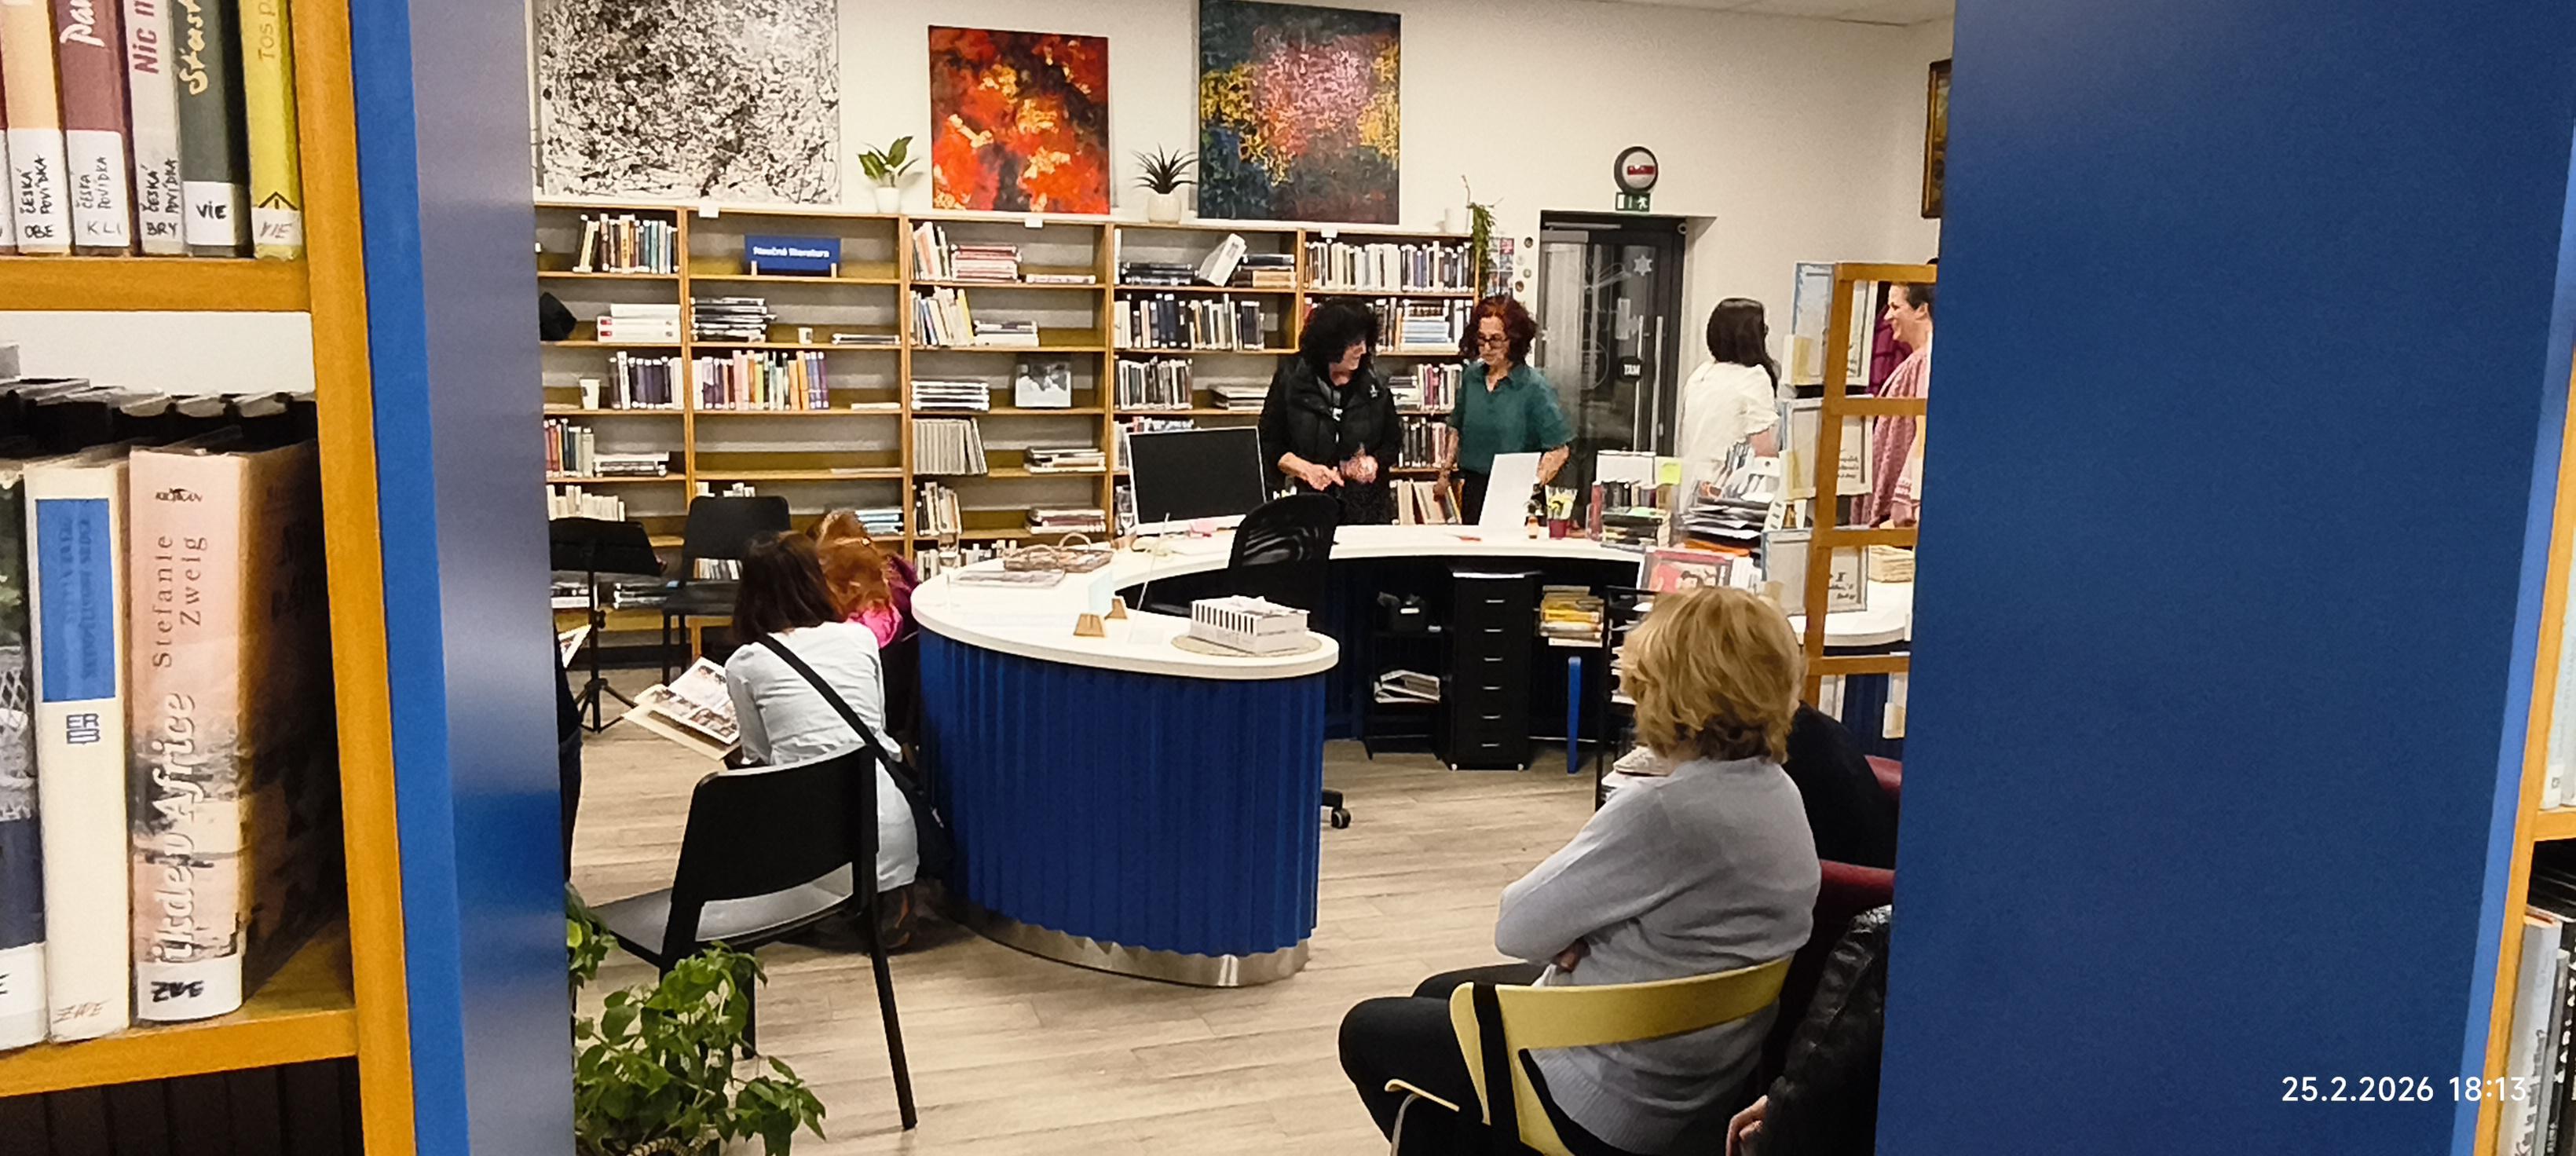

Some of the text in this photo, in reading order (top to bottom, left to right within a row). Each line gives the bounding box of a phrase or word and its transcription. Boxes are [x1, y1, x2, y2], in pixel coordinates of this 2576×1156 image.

[132, 27, 159, 74] Nic
[34, 154, 53, 214] POVÍDKA
[152, 536, 174, 668] Stefanie
[180, 536, 207, 626] Zweig
[152, 692, 205, 823] Africe
[152, 865, 196, 964] ikde
